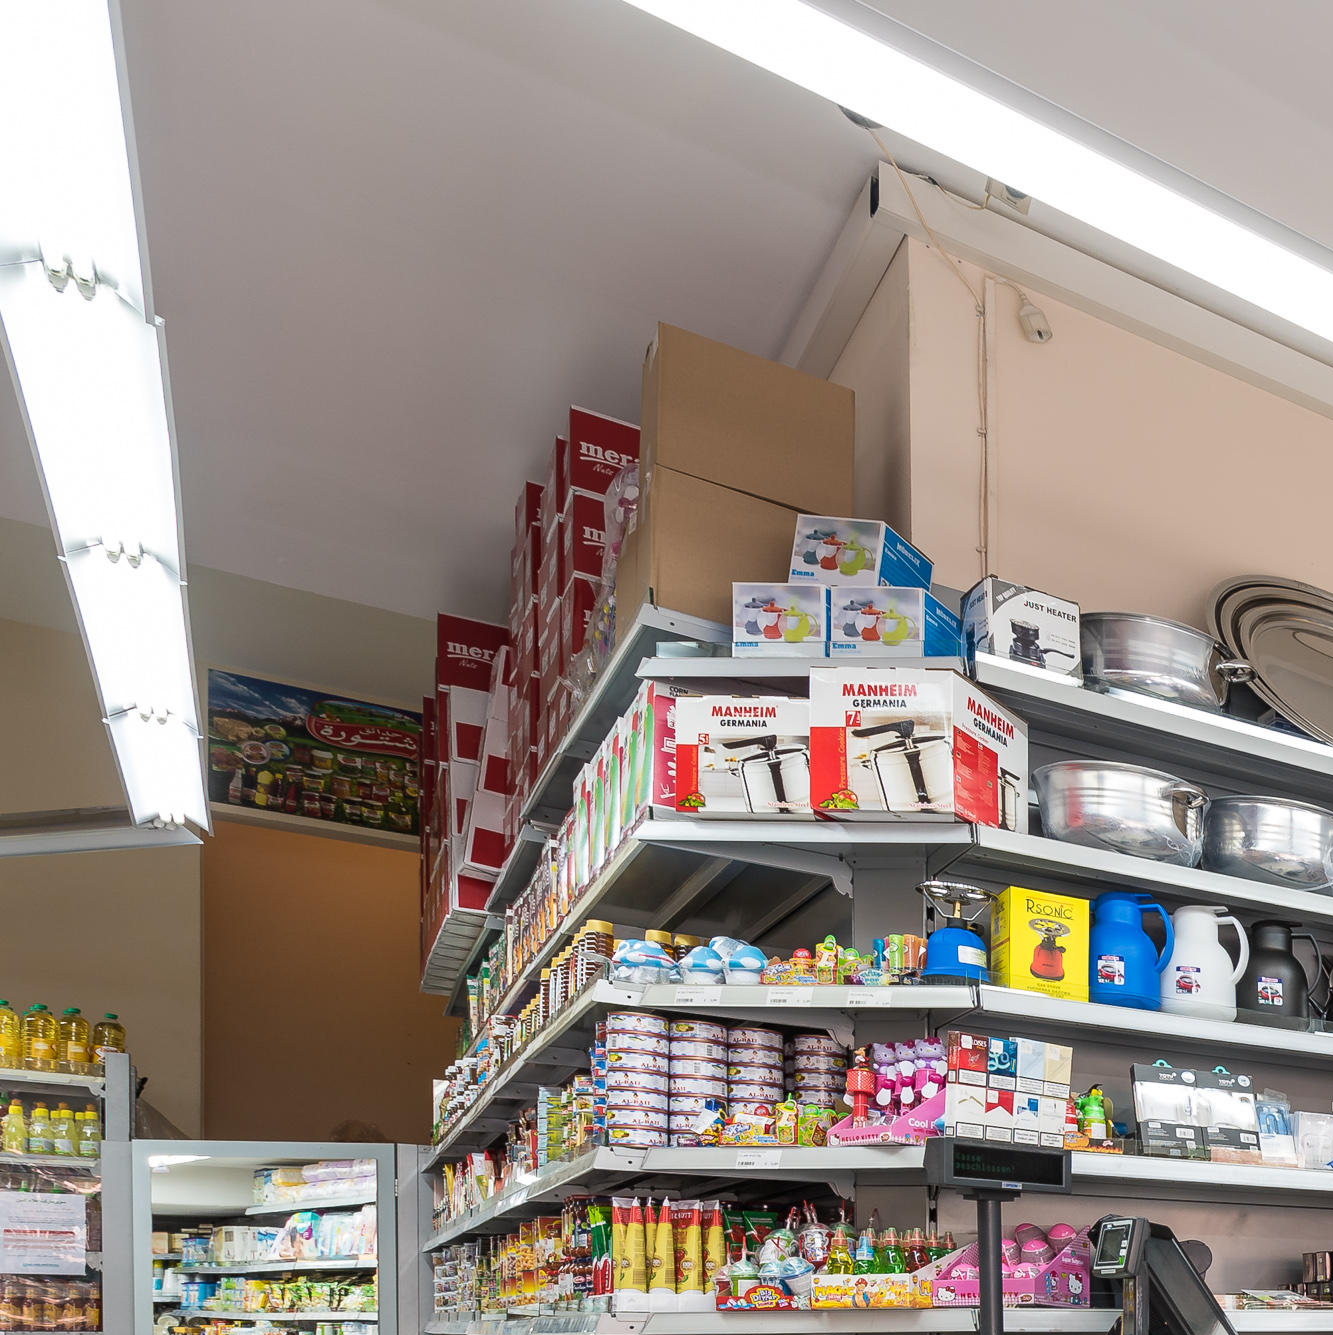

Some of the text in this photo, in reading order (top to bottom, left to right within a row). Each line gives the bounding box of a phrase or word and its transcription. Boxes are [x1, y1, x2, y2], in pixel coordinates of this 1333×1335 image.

[579, 441, 640, 467] mer
[791, 569, 815, 577] Emma
[1023, 599, 1077, 623] JUST HEATER
[832, 642, 856, 650] Emma
[669, 686, 688, 694] CORN
[842, 683, 918, 698] MANHEIM
[853, 698, 907, 709] GERMANIA
[711, 705, 777, 719] MANHEIM
[967, 697, 1014, 740] MANHEIM
[720, 718, 768, 728] GERMANIA
[973, 717, 1008, 748] GERMANIA
[908, 1117, 929, 1129] Cool
[841, 1131, 880, 1145] HELLO KITTY
